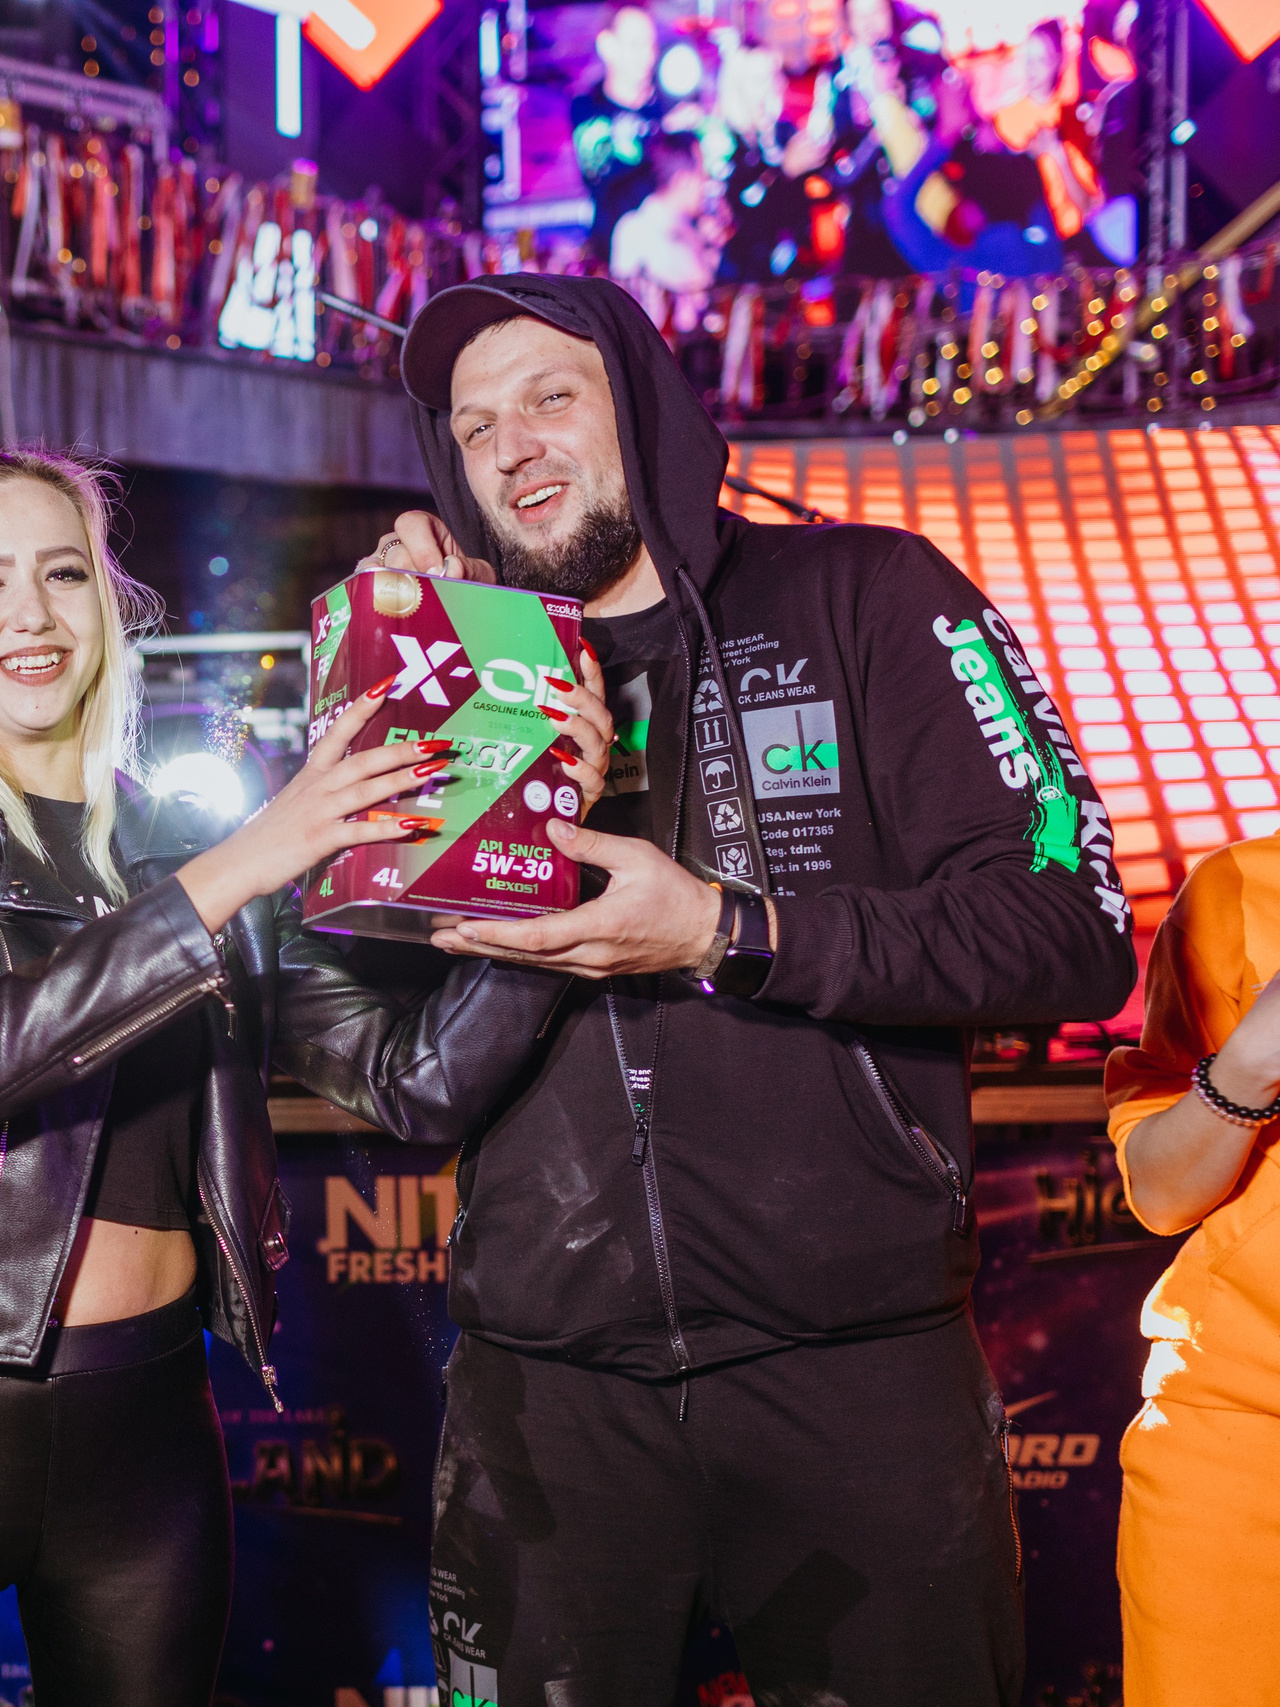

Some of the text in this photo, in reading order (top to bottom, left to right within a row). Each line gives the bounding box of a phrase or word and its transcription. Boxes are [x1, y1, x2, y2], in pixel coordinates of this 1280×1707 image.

[736, 633, 764, 645] WEAR
[722, 640, 779, 658] treet clothing
[316, 653, 332, 681] FE
[731, 656, 751, 666] York
[738, 684, 816, 704] CK JEANS WEAR
[932, 614, 1041, 789] Jeans
[473, 701, 518, 716] GASOLINE
[606, 764, 640, 783] lein
[761, 775, 831, 791] Calvin Klein
[815, 807, 842, 819] York
[761, 825, 834, 841] Code 017365
[477, 839, 552, 860] API SN/CF
[789, 843, 822, 855] tdmk
[471, 852, 554, 881] 5W-30
[788, 861, 800, 872] in
[803, 859, 832, 872] 1996
[319, 876, 334, 898] 4L
[372, 867, 404, 889] 4L
[485, 877, 539, 895] dexos1
[465, 1644, 486, 1659] WEAR
